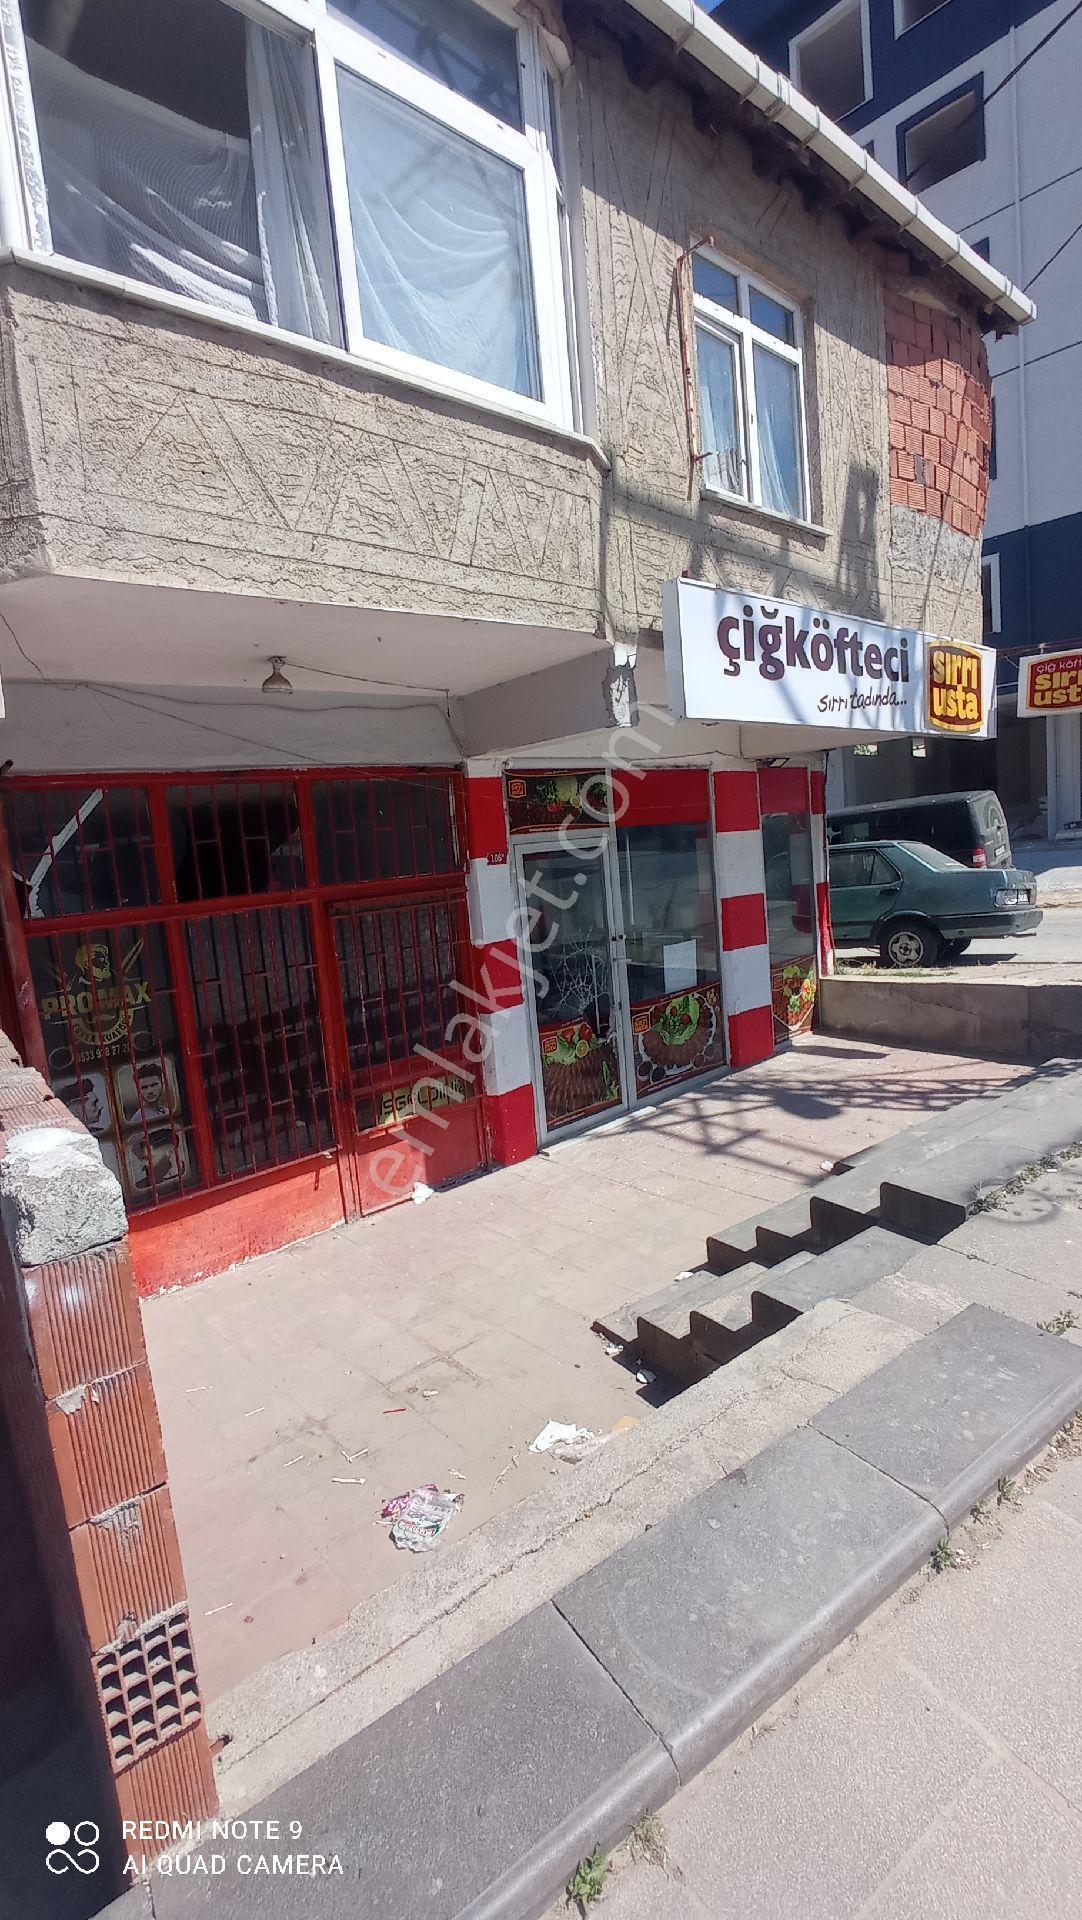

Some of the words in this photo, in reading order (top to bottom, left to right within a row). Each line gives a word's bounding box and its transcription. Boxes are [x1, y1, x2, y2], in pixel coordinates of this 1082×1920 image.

[717, 604, 910, 682] çiğköfteci
[932, 650, 978, 690] sırrı
[1034, 670, 1082, 691] sır
[932, 683, 980, 720] usta
